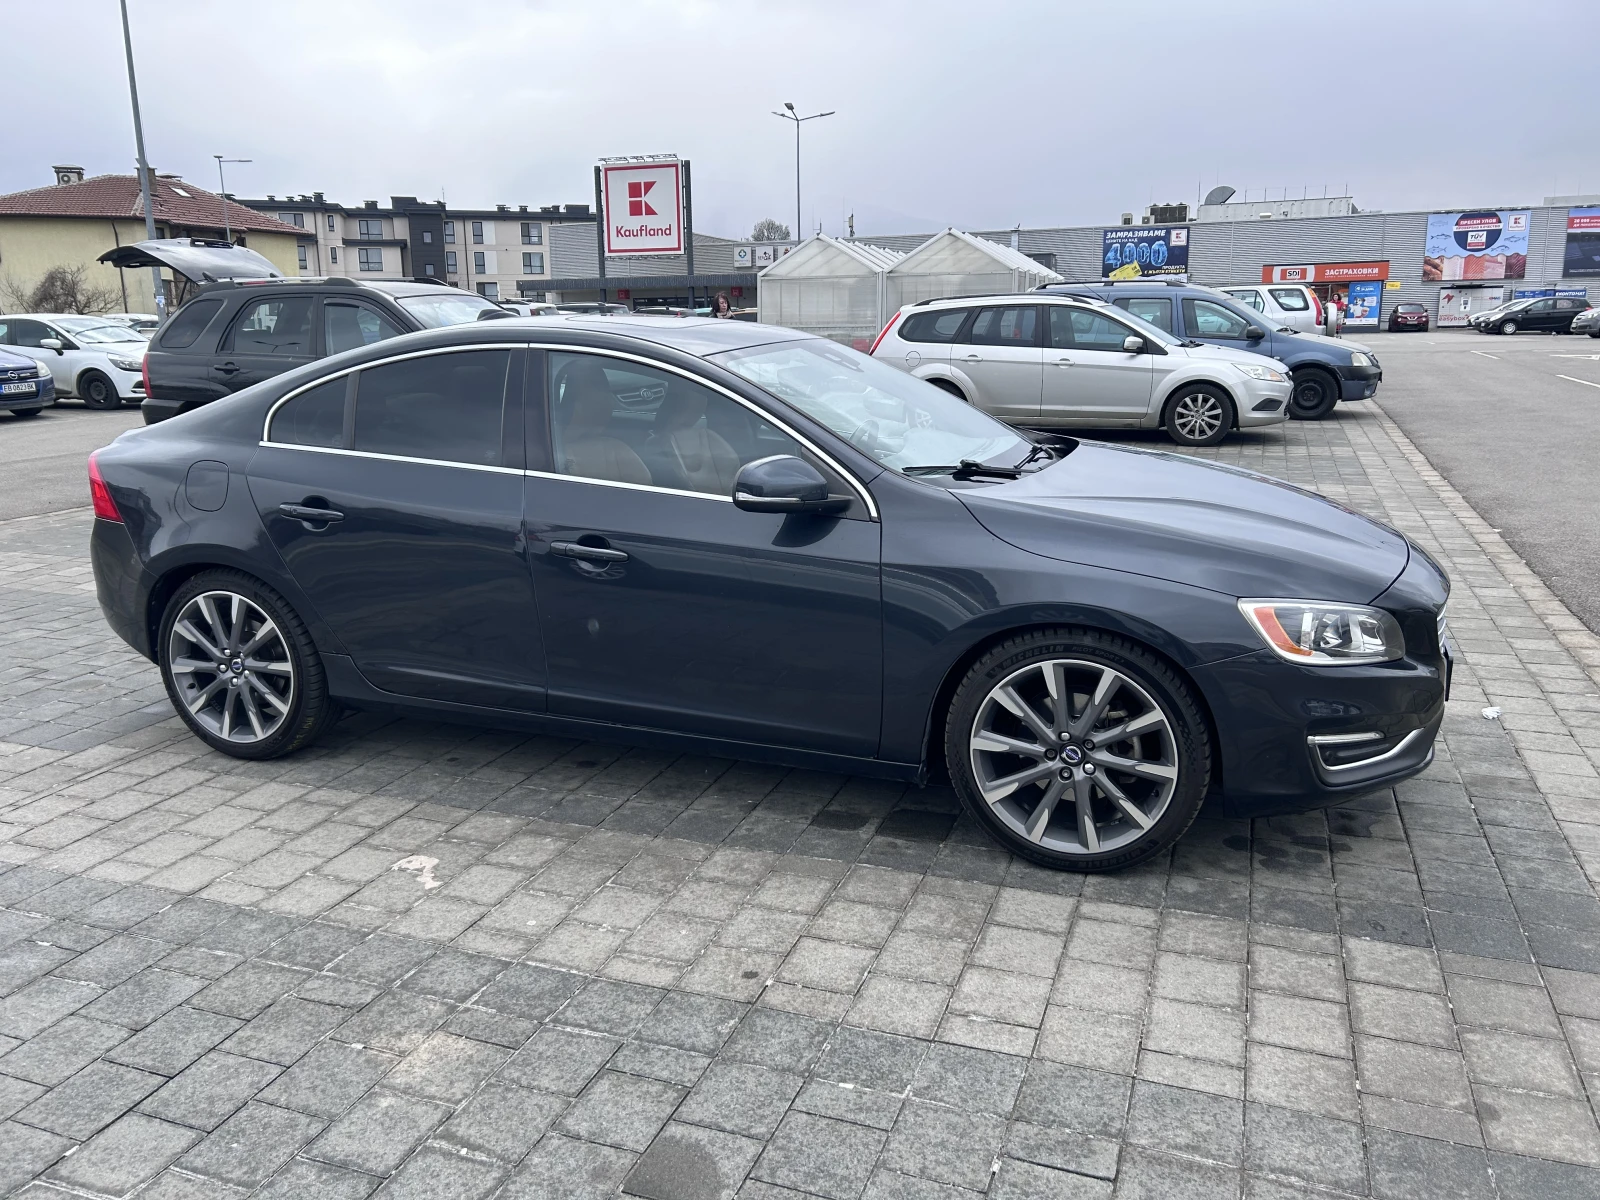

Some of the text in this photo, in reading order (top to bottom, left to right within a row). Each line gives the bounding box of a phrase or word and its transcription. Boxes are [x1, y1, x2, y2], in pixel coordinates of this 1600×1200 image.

[616, 224, 672, 237] Kaufland
[1106, 230, 1166, 238] ЗАМРАЗЯВАМЕ
[1105, 240, 1168, 268] 4000
[1324, 267, 1379, 276] ЗАСТРАХОВКИ
[1003, 645, 1064, 668] MICHELIN
